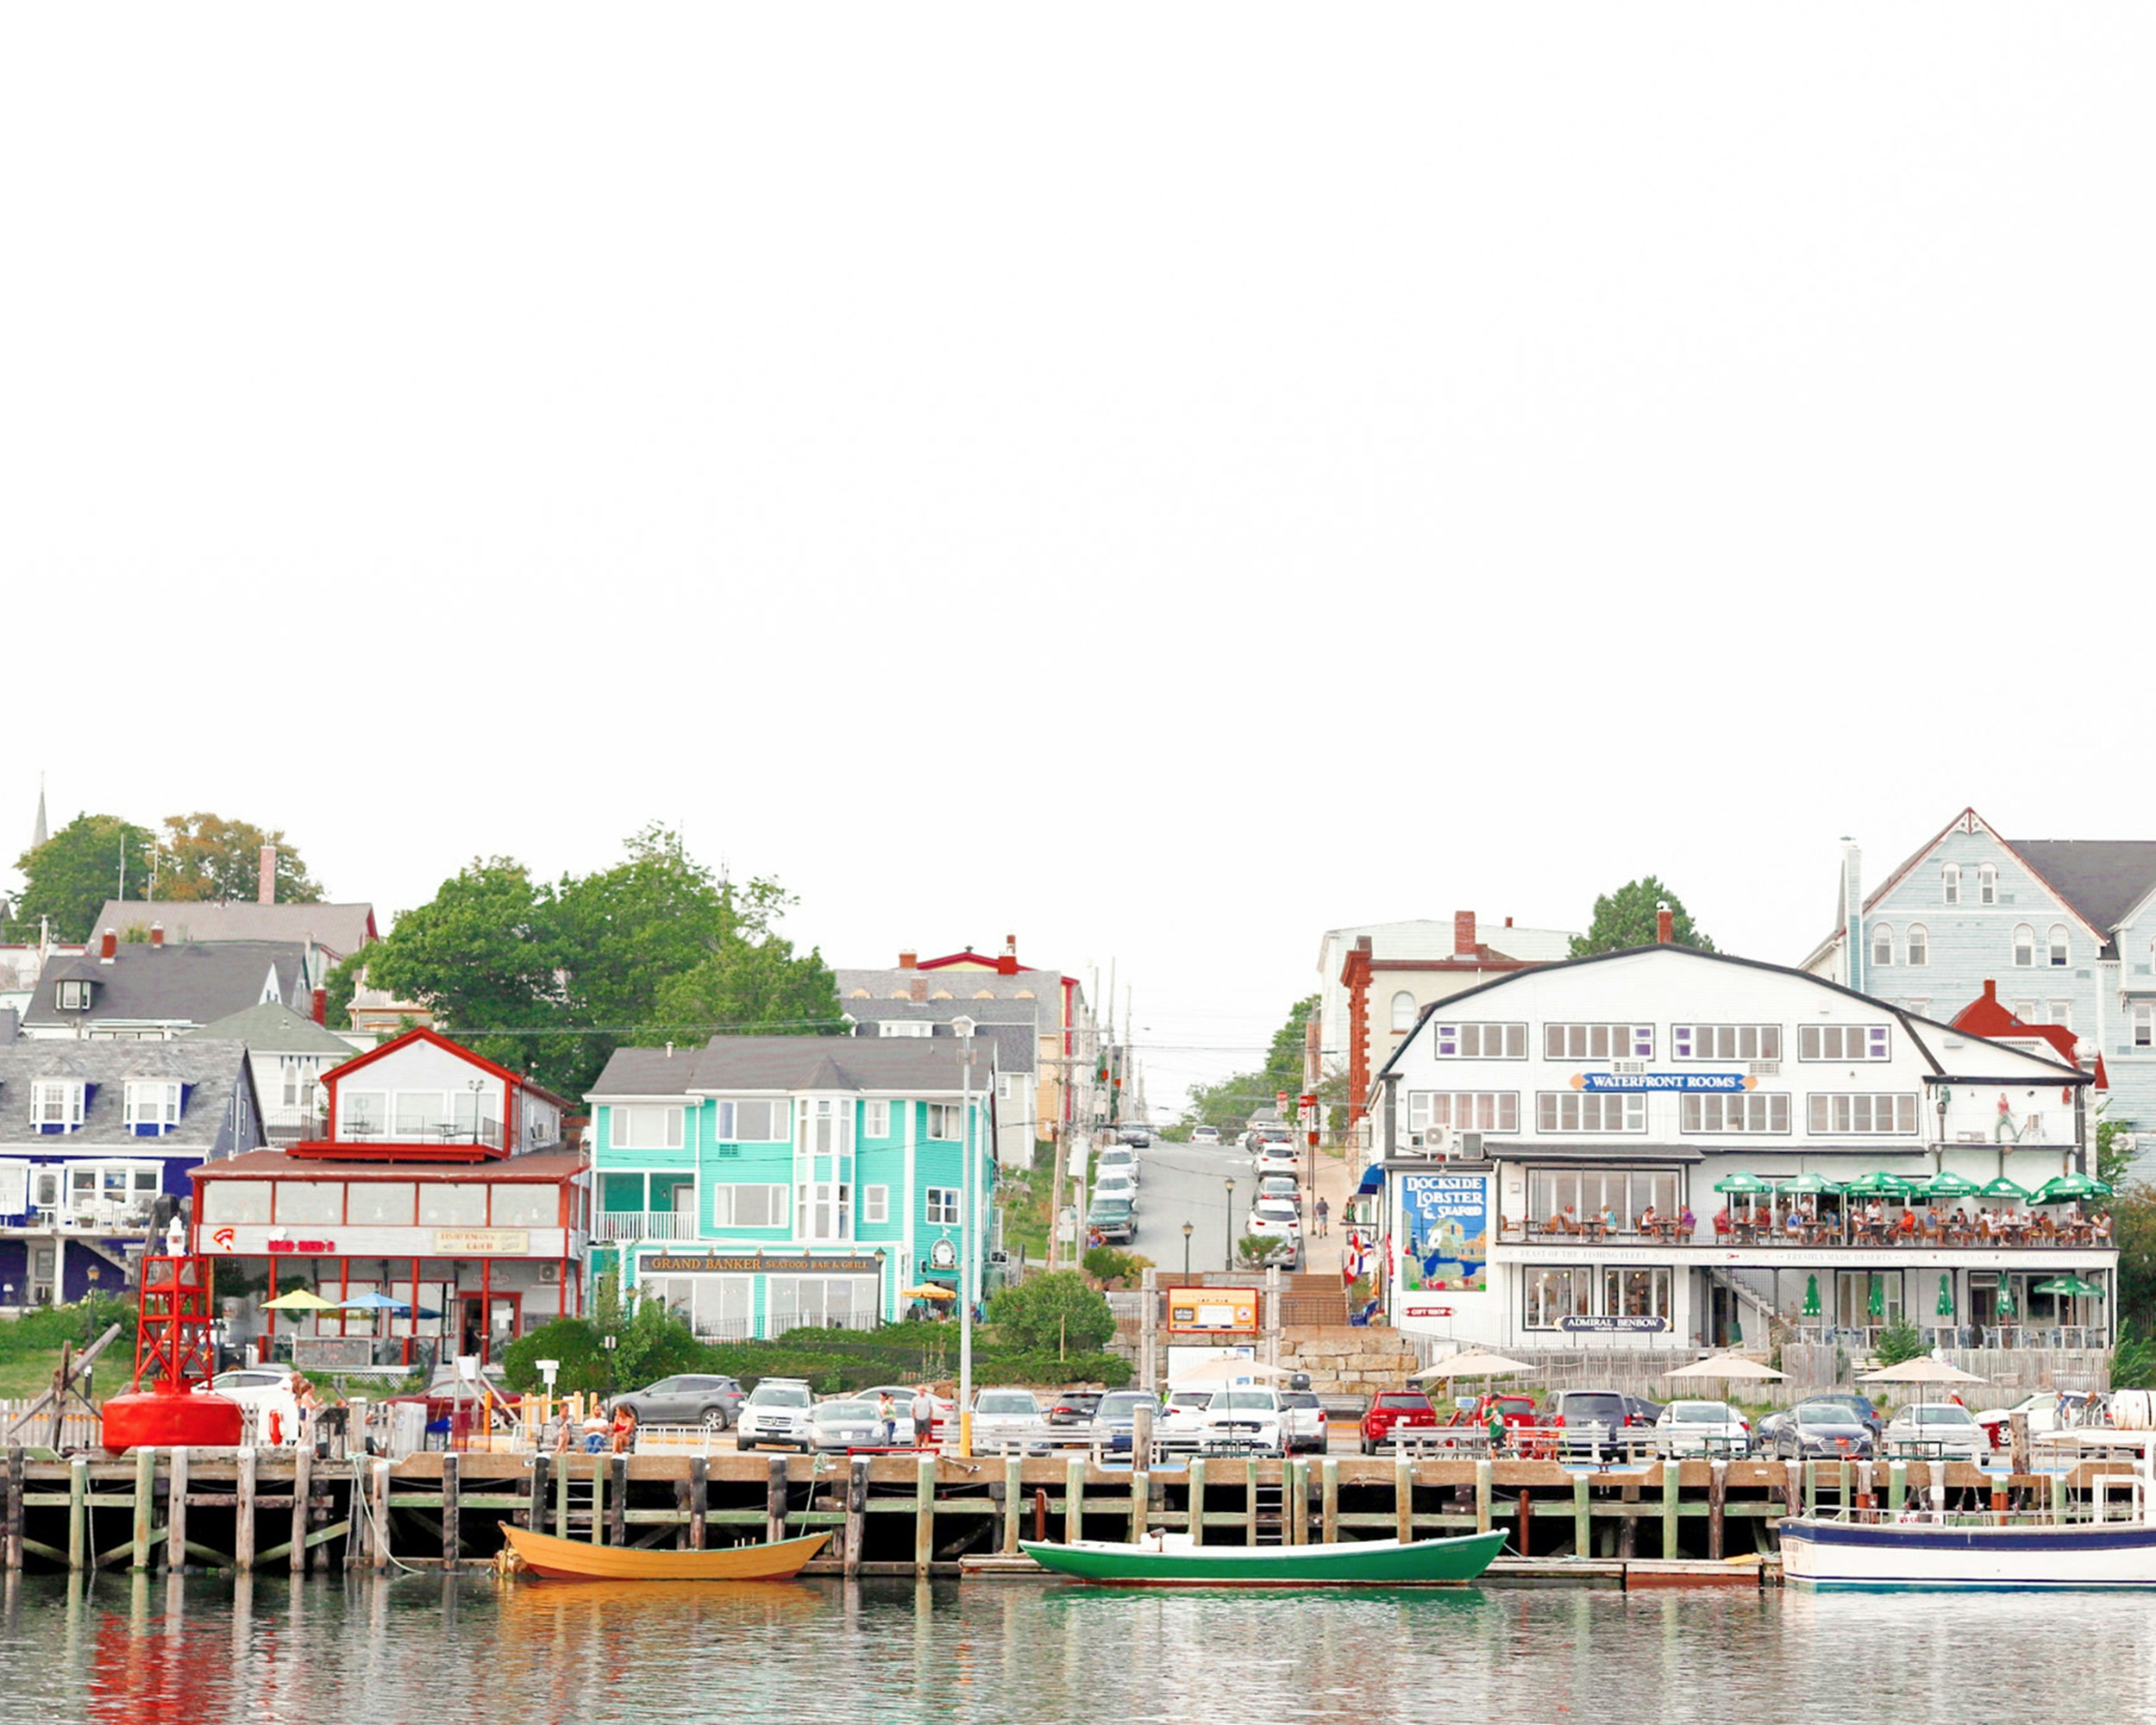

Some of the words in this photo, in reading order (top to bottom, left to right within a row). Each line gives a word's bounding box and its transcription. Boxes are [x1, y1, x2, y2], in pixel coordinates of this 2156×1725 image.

[1592, 1076, 1683, 1088] WATERFRONT
[1687, 1076, 1734, 1088] ROOMS
[1406, 1177, 1483, 1191] DOCKSIDE
[1416, 1190, 1485, 1208] LOBSTER
[1423, 1208, 1437, 1220] &
[653, 1258, 701, 1270] GRAND
[705, 1258, 762, 1270] BANKER
[766, 1260, 809, 1269] SEAFOOD
[812, 1260, 830, 1269] BAR
[842, 1260, 869, 1270] GRILL
[1567, 1318, 1613, 1327] ADMIRAL
[1616, 1318, 1658, 1327] BENBOW
